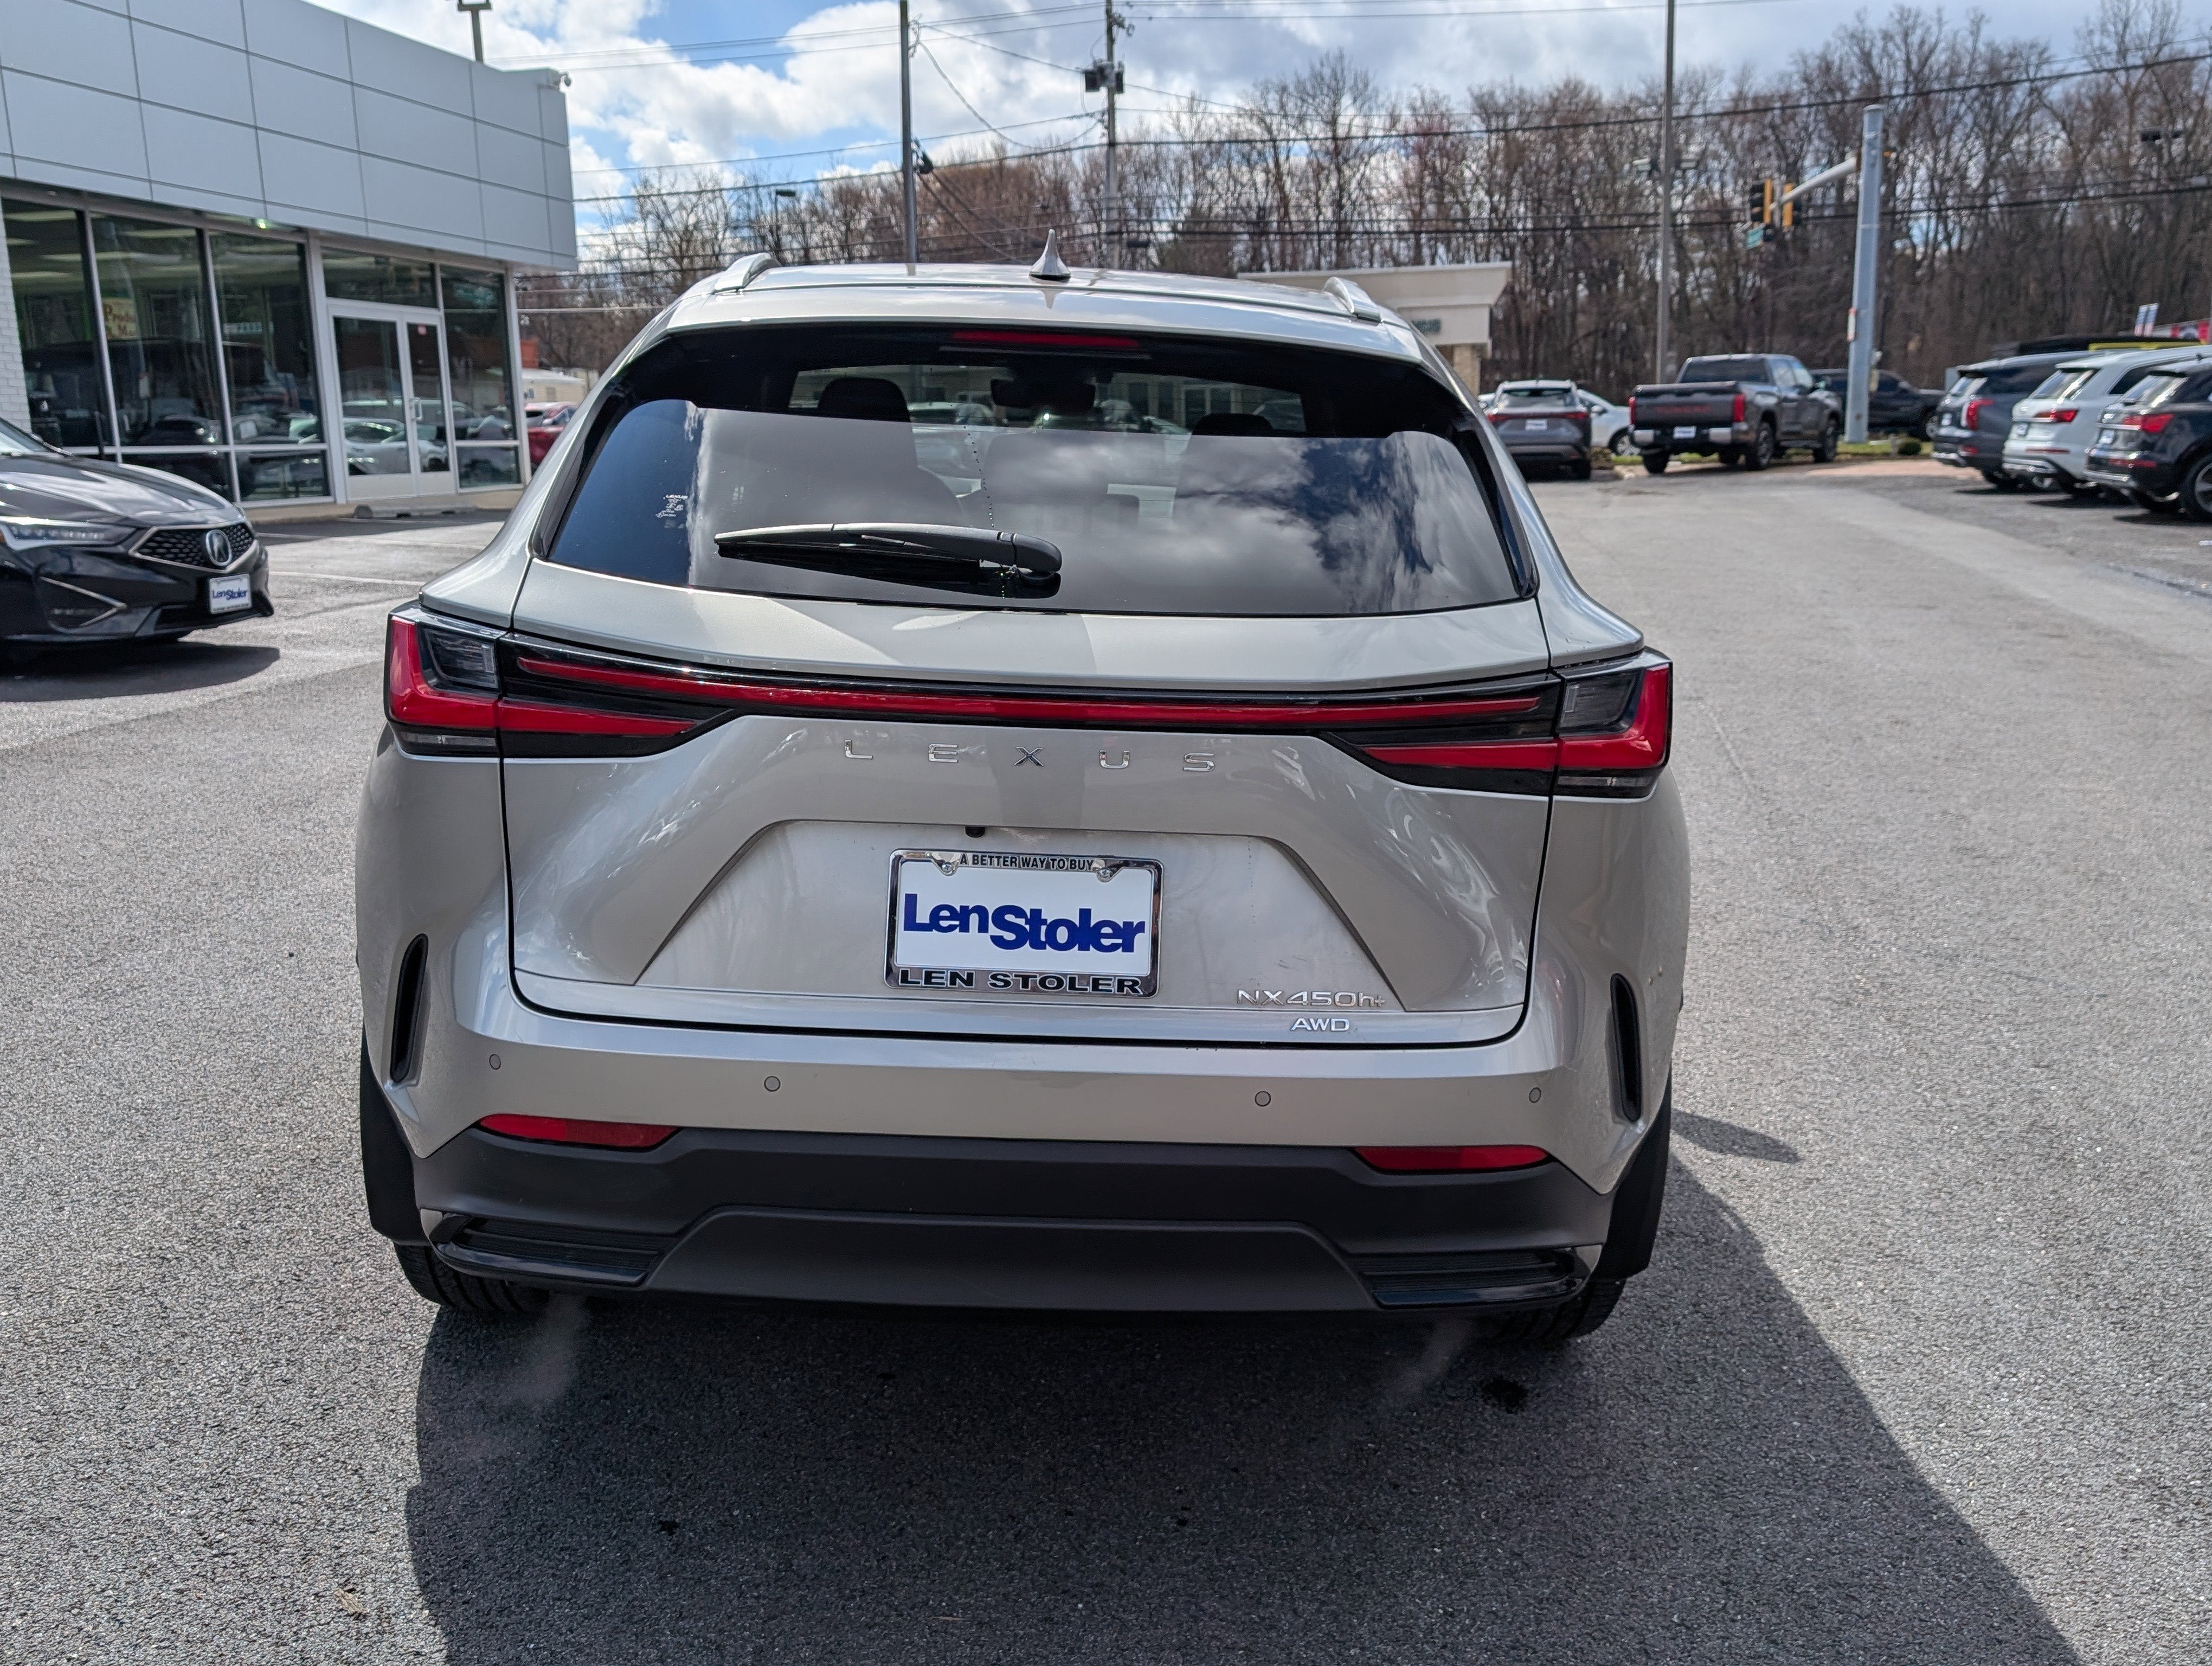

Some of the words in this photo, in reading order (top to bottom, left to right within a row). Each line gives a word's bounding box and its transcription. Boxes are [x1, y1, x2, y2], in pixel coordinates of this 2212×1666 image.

[844, 739, 1215, 772] LEXUS
[960, 854, 968, 865] A
[972, 855, 1018, 868] BETTER
[1021, 856, 1046, 869] WAY
[1050, 858, 1067, 870] TO
[1070, 859, 1094, 871] BUY
[898, 969, 975, 988] LEN
[987, 972, 1143, 995] STOLER
[1290, 1017, 1350, 1031] AWD
